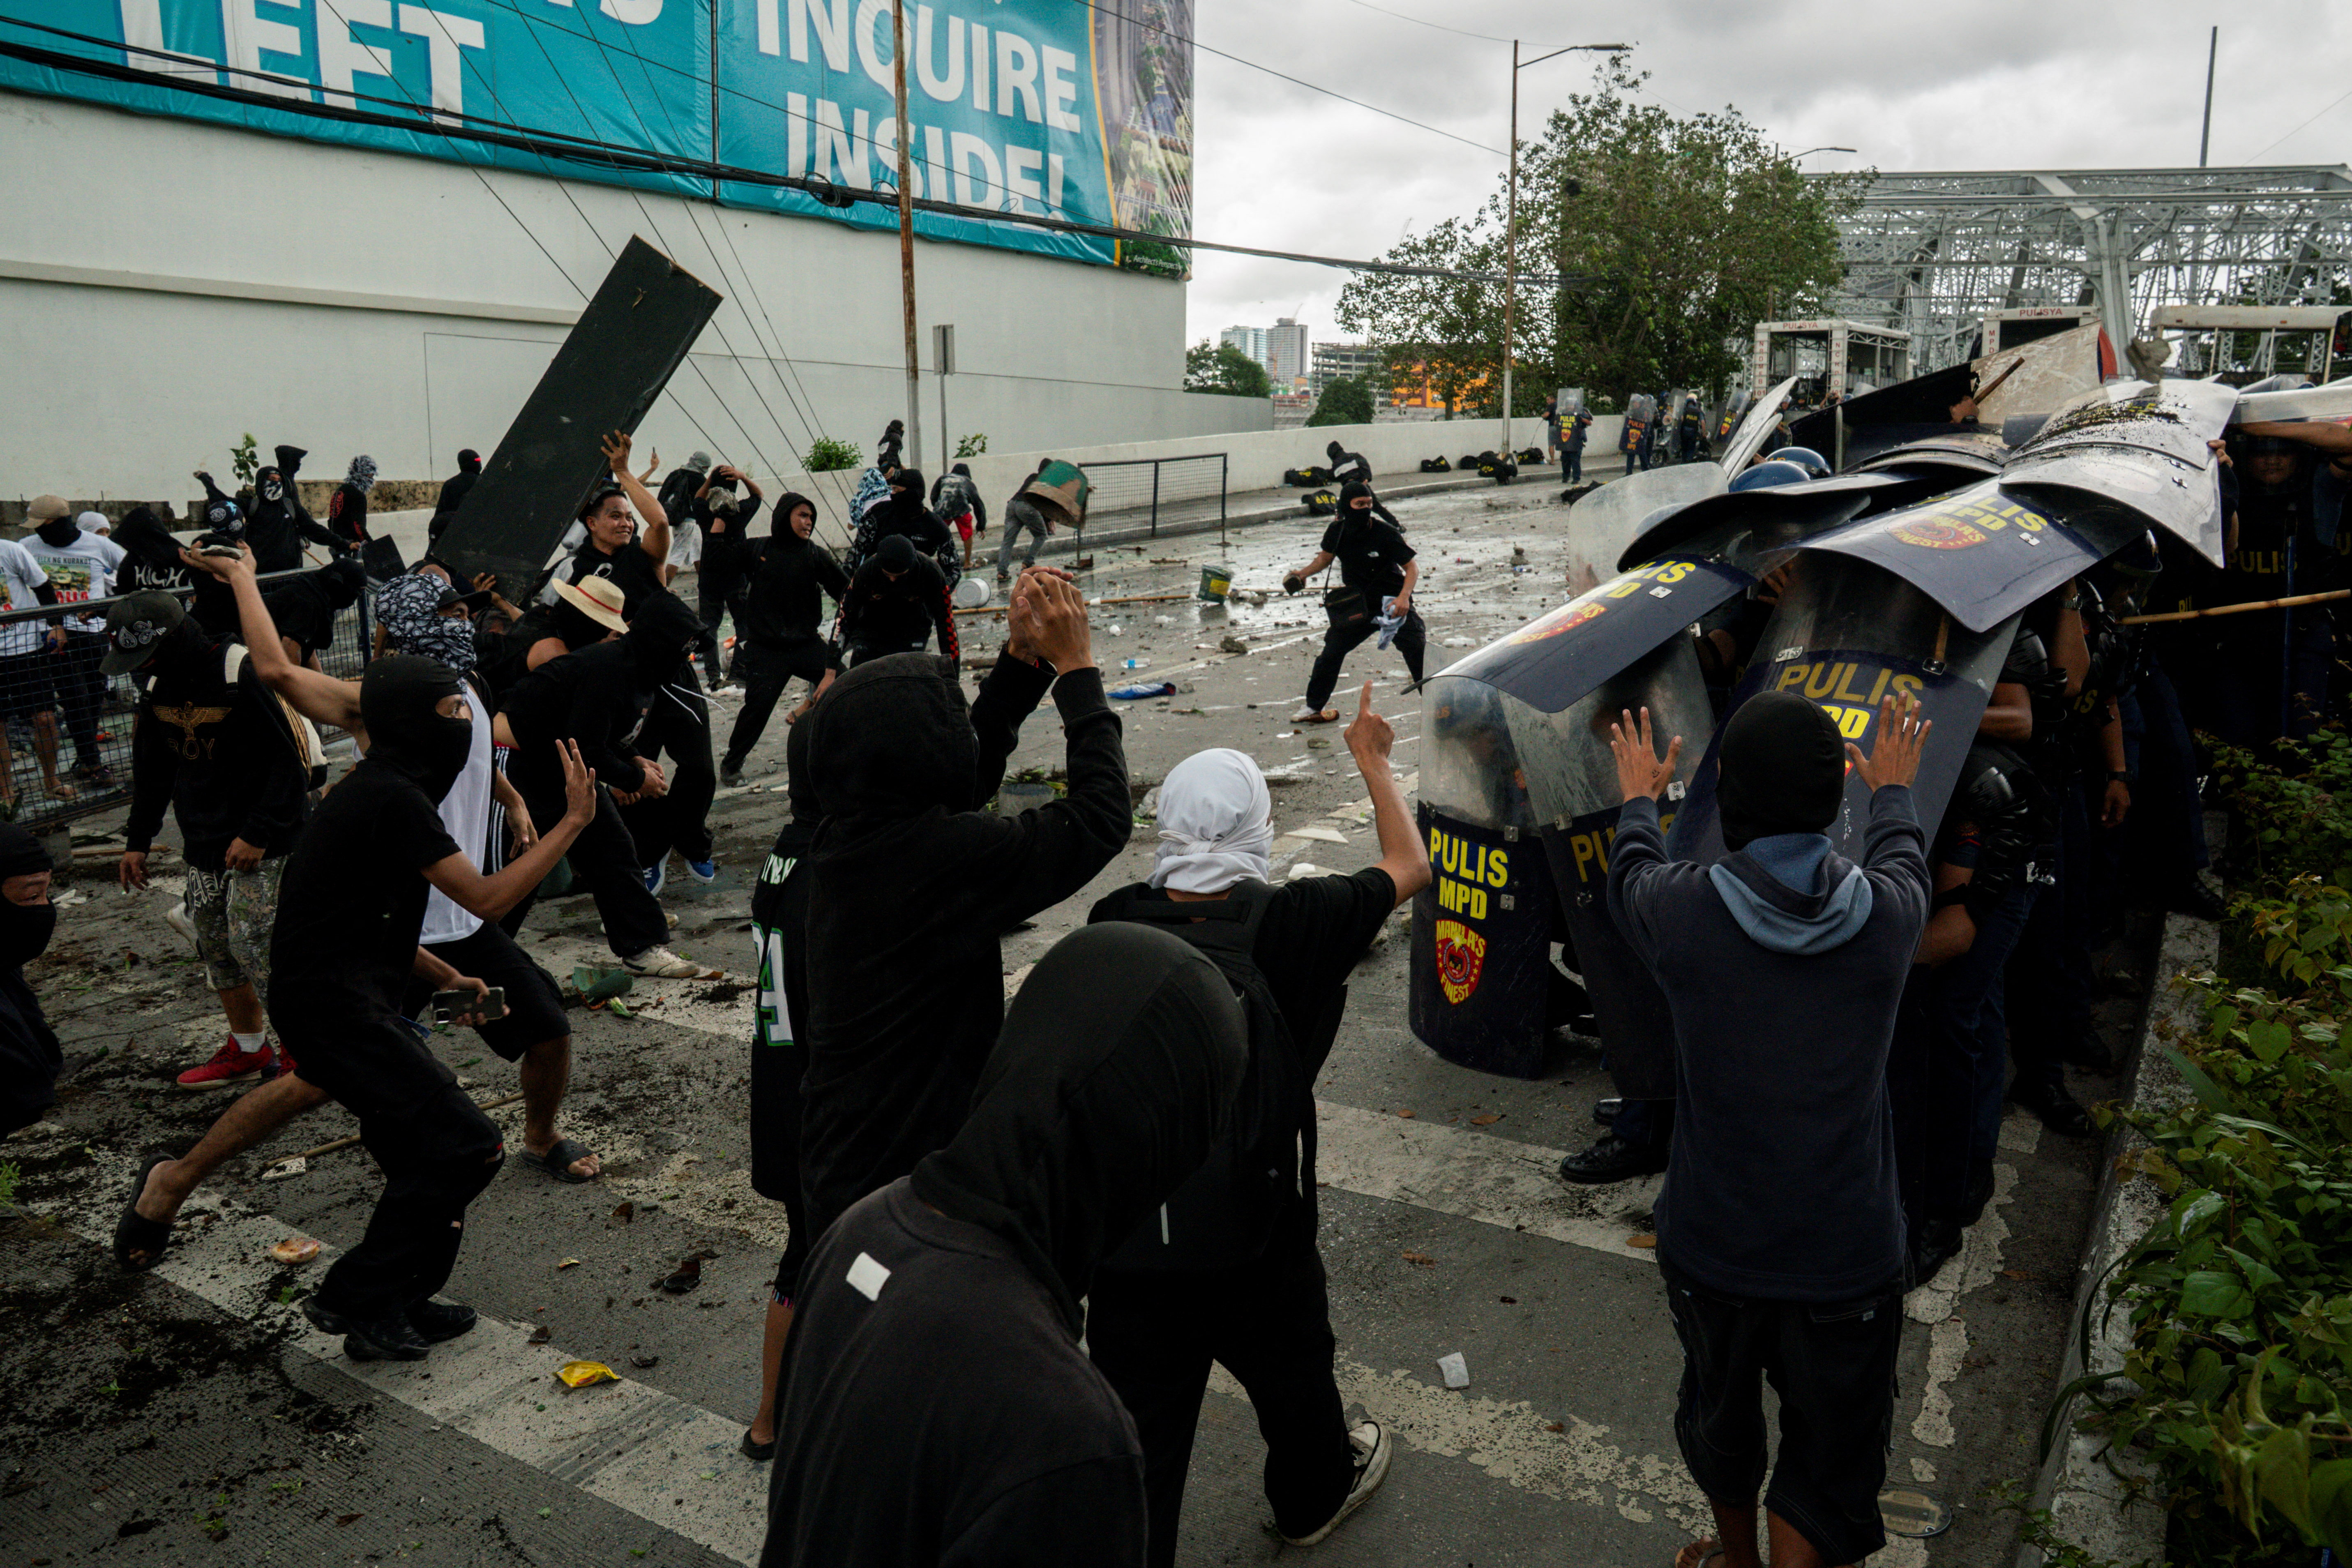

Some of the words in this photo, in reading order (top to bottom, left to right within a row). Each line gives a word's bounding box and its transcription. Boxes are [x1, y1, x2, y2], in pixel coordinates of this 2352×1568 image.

[120, 0, 485, 128] LEFT
[756, 0, 1081, 134] INQUIRE
[787, 92, 1065, 236] INSIDE!
[1133, 255, 1158, 266] Architect's
[1628, 420, 1645, 429] PULIS
[1775, 662, 1923, 712] PULIS
[1430, 827, 1509, 888] PULIS
[1439, 877, 1487, 920] MPD
[1436, 920, 1485, 958] MANILA'S
[1441, 973, 1469, 1003] FINEST
